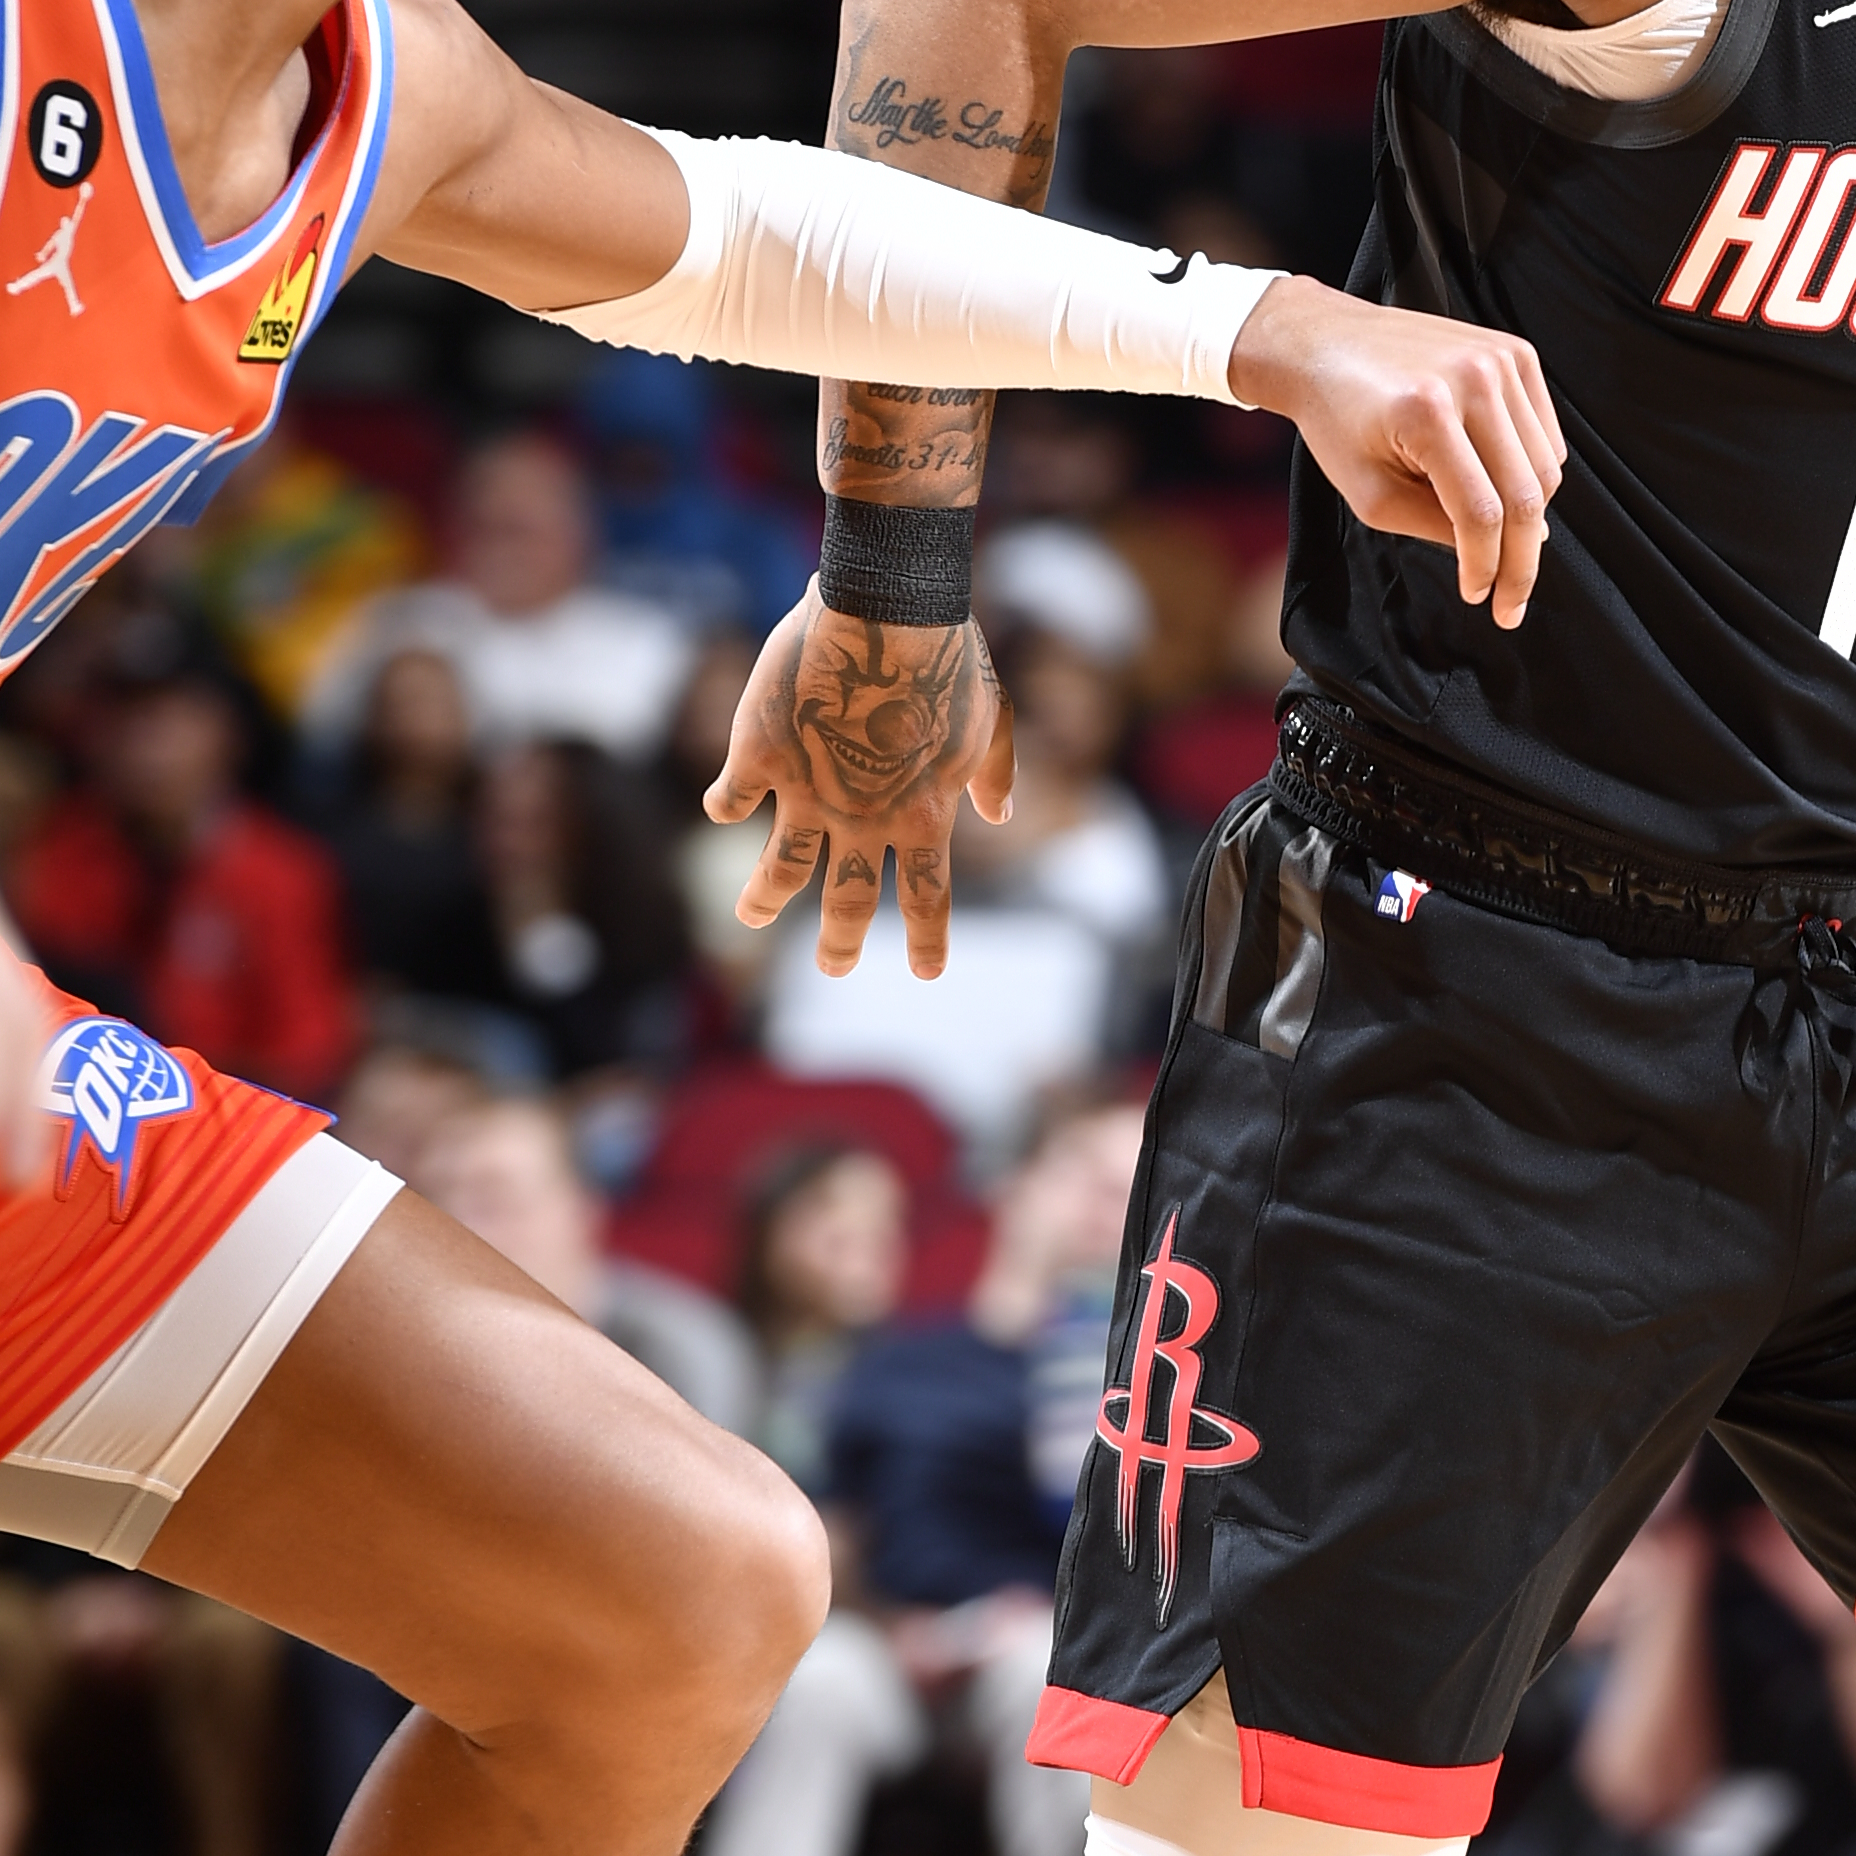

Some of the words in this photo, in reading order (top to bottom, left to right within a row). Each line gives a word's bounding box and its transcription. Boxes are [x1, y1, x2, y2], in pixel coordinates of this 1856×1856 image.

[40, 94, 88, 178] 6
[1377, 894, 1401, 917] NBA
[73, 1028, 140, 1154] OKC
